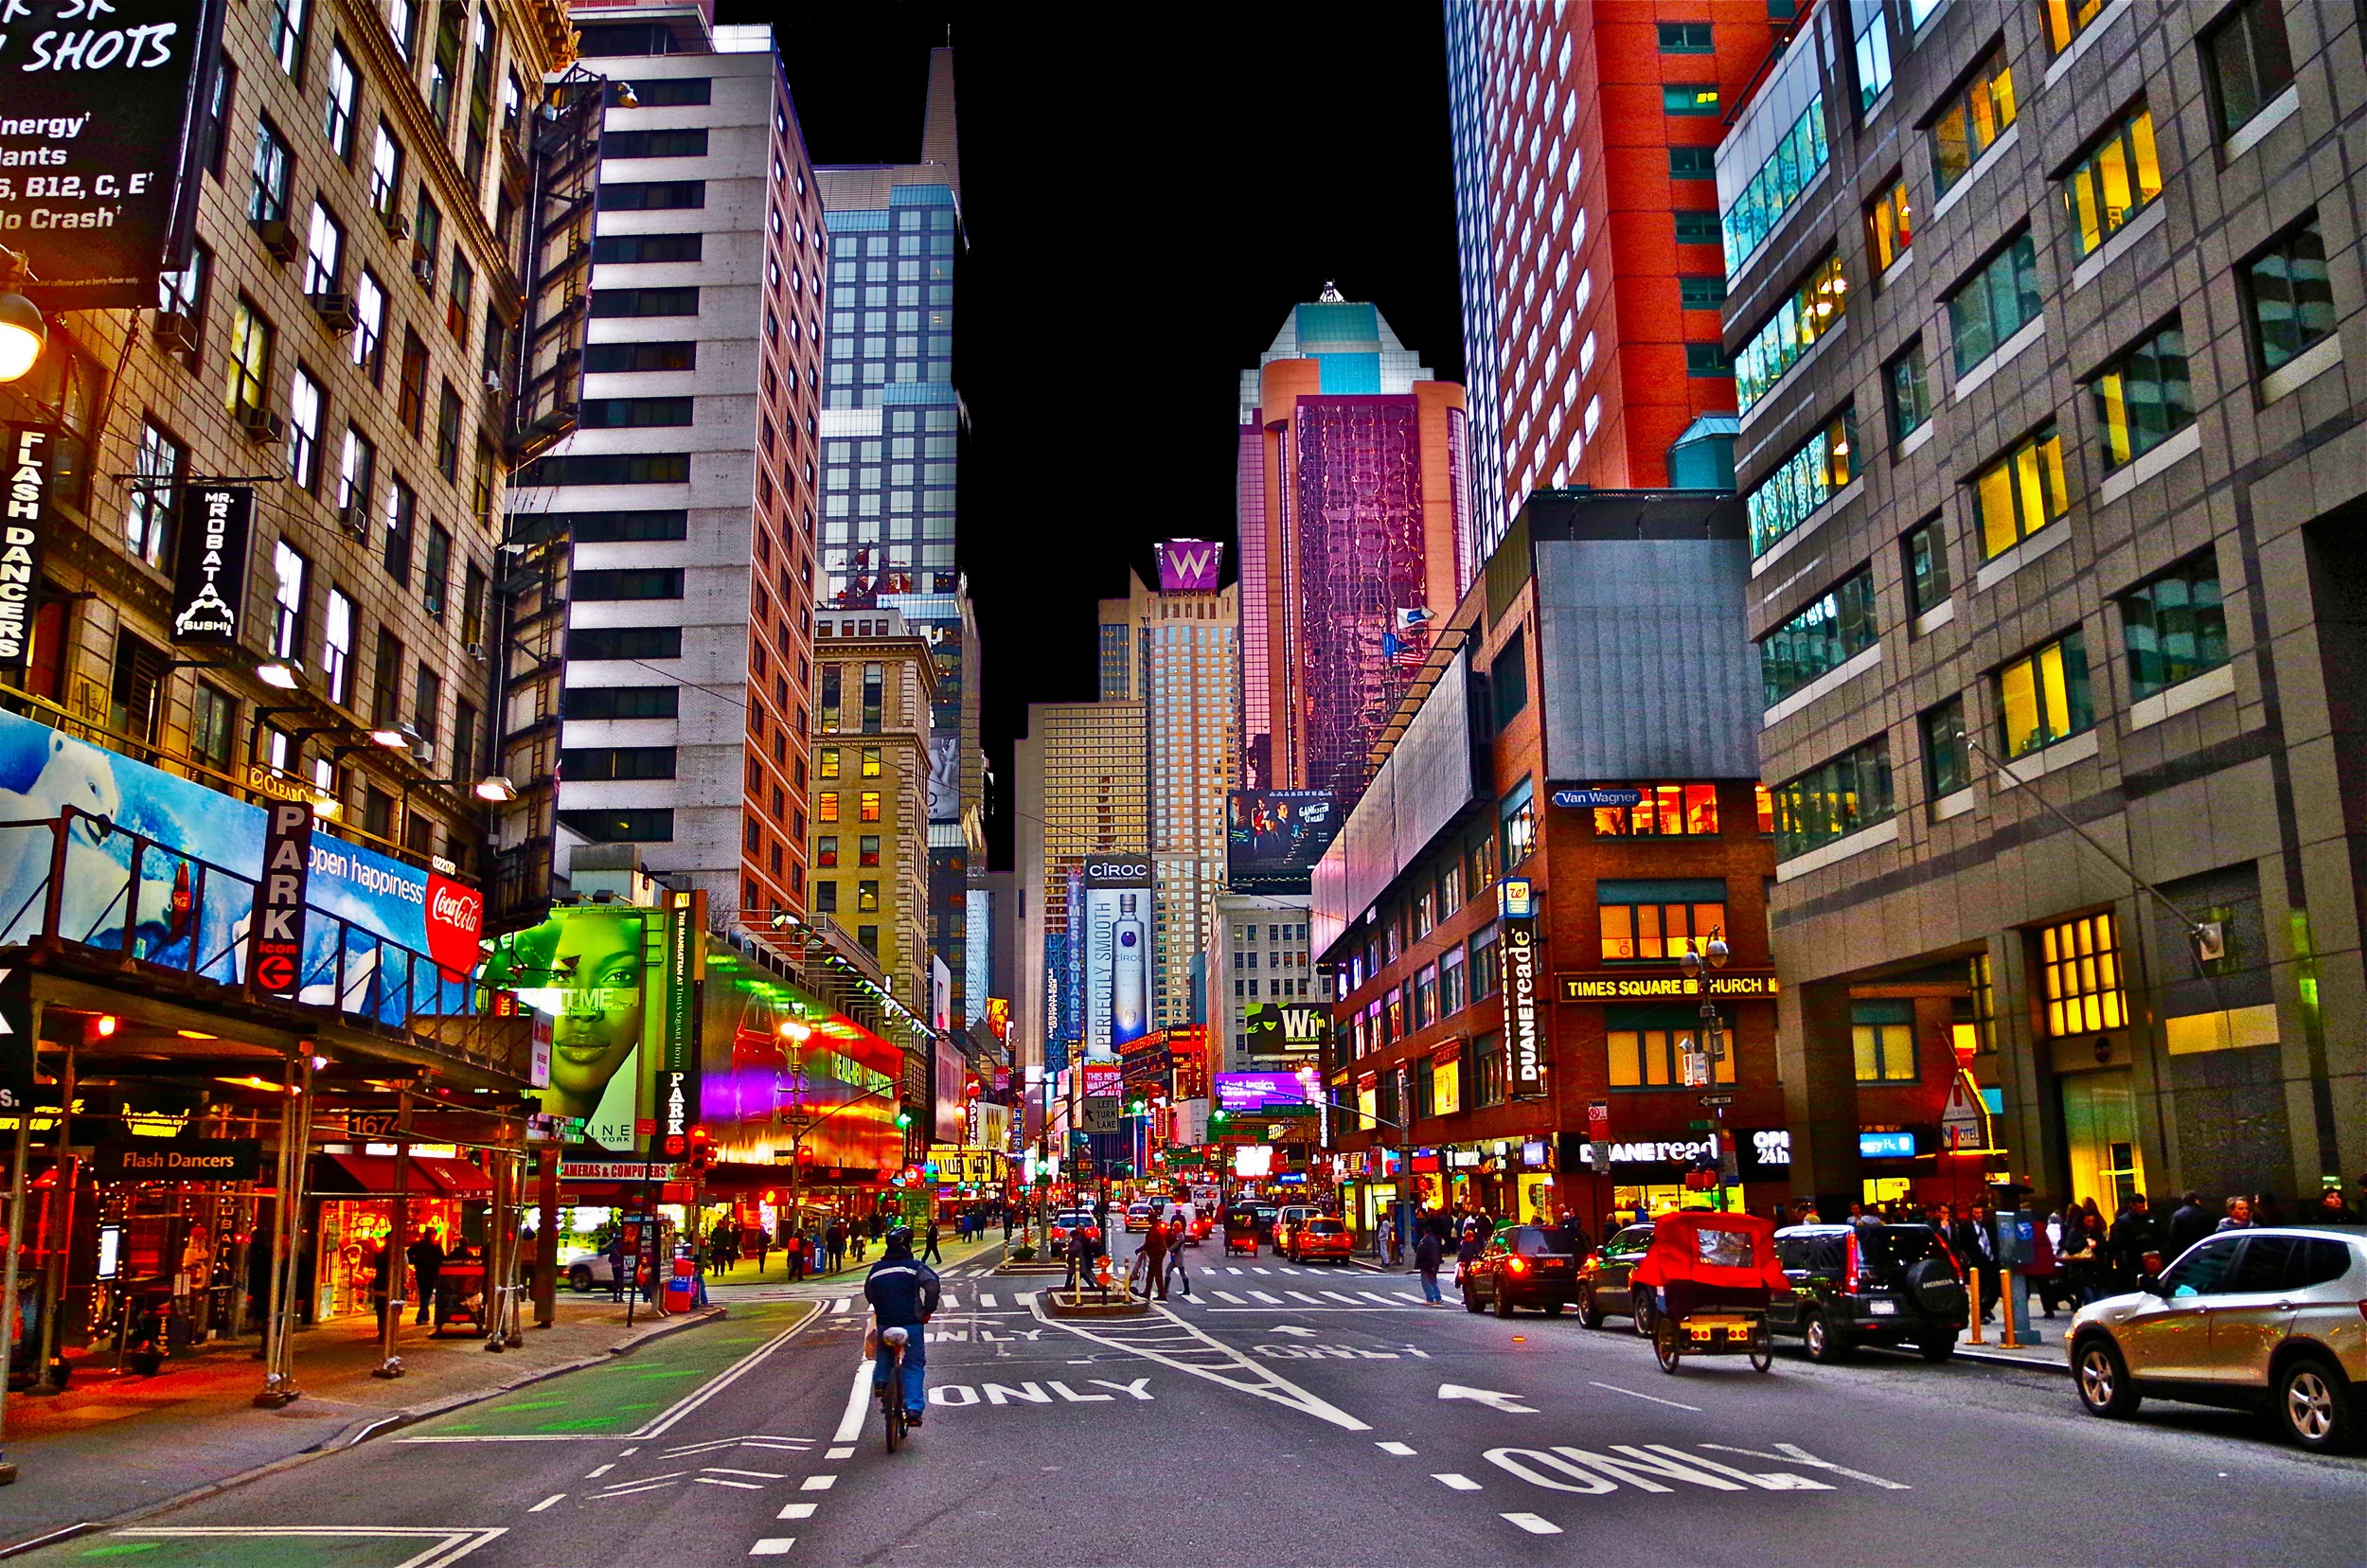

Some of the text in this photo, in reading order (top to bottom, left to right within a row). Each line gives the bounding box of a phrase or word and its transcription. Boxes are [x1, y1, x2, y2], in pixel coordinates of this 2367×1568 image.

[22, 23, 177, 72] SHOTS
[0, 111, 91, 138] nergy†
[26, 176, 86, 200] B12,
[95, 175, 120, 198] C,
[205, 492, 235, 504] MR.
[0, 431, 45, 657] FLASH DANCERS
[199, 503, 228, 597] ROBATA
[1167, 549, 1210, 580] W
[184, 620, 228, 632] SUSHI
[1561, 792, 1638, 805] Van Wagner
[263, 806, 306, 940] PARK
[308, 845, 423, 905] open happiness
[1089, 863, 1148, 877] CÎROC
[1068, 882, 1080, 942] TIMES
[1095, 902, 1112, 961] SMOOTH
[258, 942, 297, 954] icon
[1069, 952, 1081, 1023] SQUARE
[1568, 981, 1615, 996] TIMES
[1618, 979, 1682, 995] SQUARE
[1095, 964, 1112, 1047] PERFECTLY
[667, 1072, 685, 1134] PARK
[1096, 1111, 1116, 1119] TURN
[1097, 1100, 1115, 1109] LEFT
[123, 1151, 235, 1167] Flash Dancers
[560, 1164, 600, 1178] AMERAS
[602, 1166, 609, 1176] &
[1193, 1191, 1219, 1201] FedEx
[1922, 1278, 1954, 1290] HONDA
[928, 1378, 1155, 1406] ONLY
[1482, 1442, 1912, 1494] ONLY
